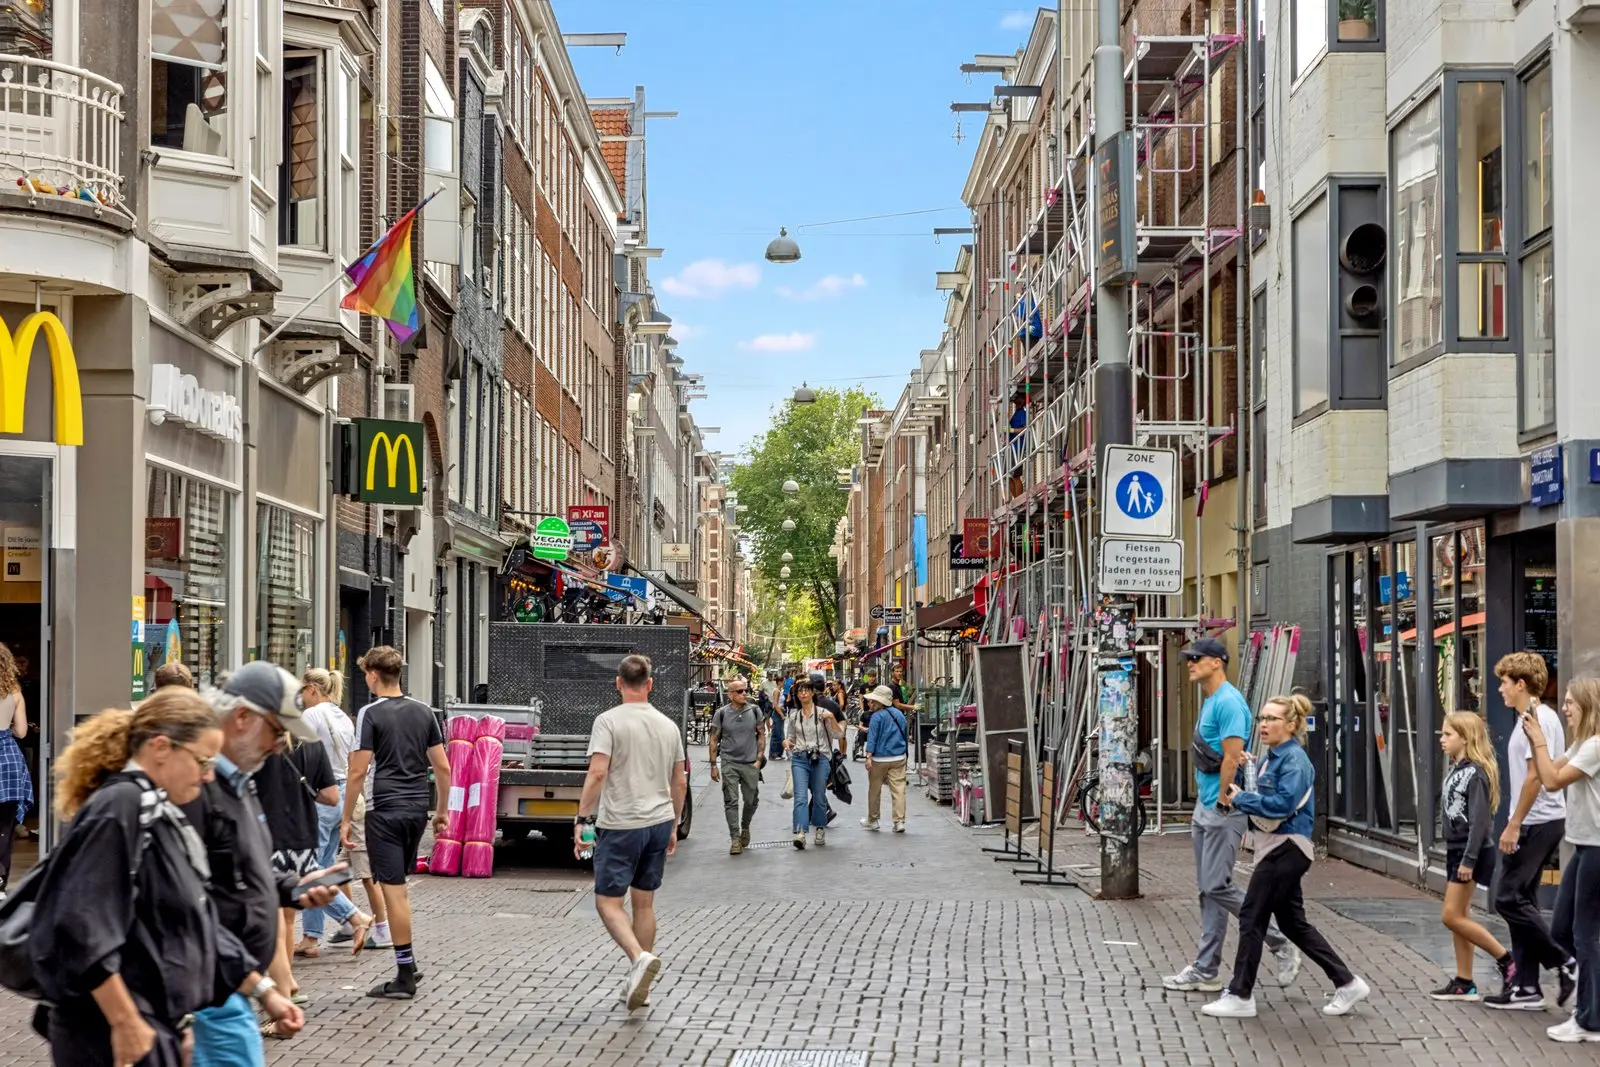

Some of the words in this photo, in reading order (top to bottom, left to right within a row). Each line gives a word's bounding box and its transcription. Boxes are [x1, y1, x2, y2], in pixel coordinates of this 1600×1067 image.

[1127, 453, 1155, 464] ZONE
[582, 510, 605, 519] Xi'an
[533, 536, 571, 544] VEGAN
[1125, 544, 1161, 552] Fietsen
[1115, 555, 1170, 565] toegestaan
[1104, 566, 1131, 574] laden
[1149, 567, 1180, 576] lossen
[1334, 581, 1342, 795] STARBUCKS
